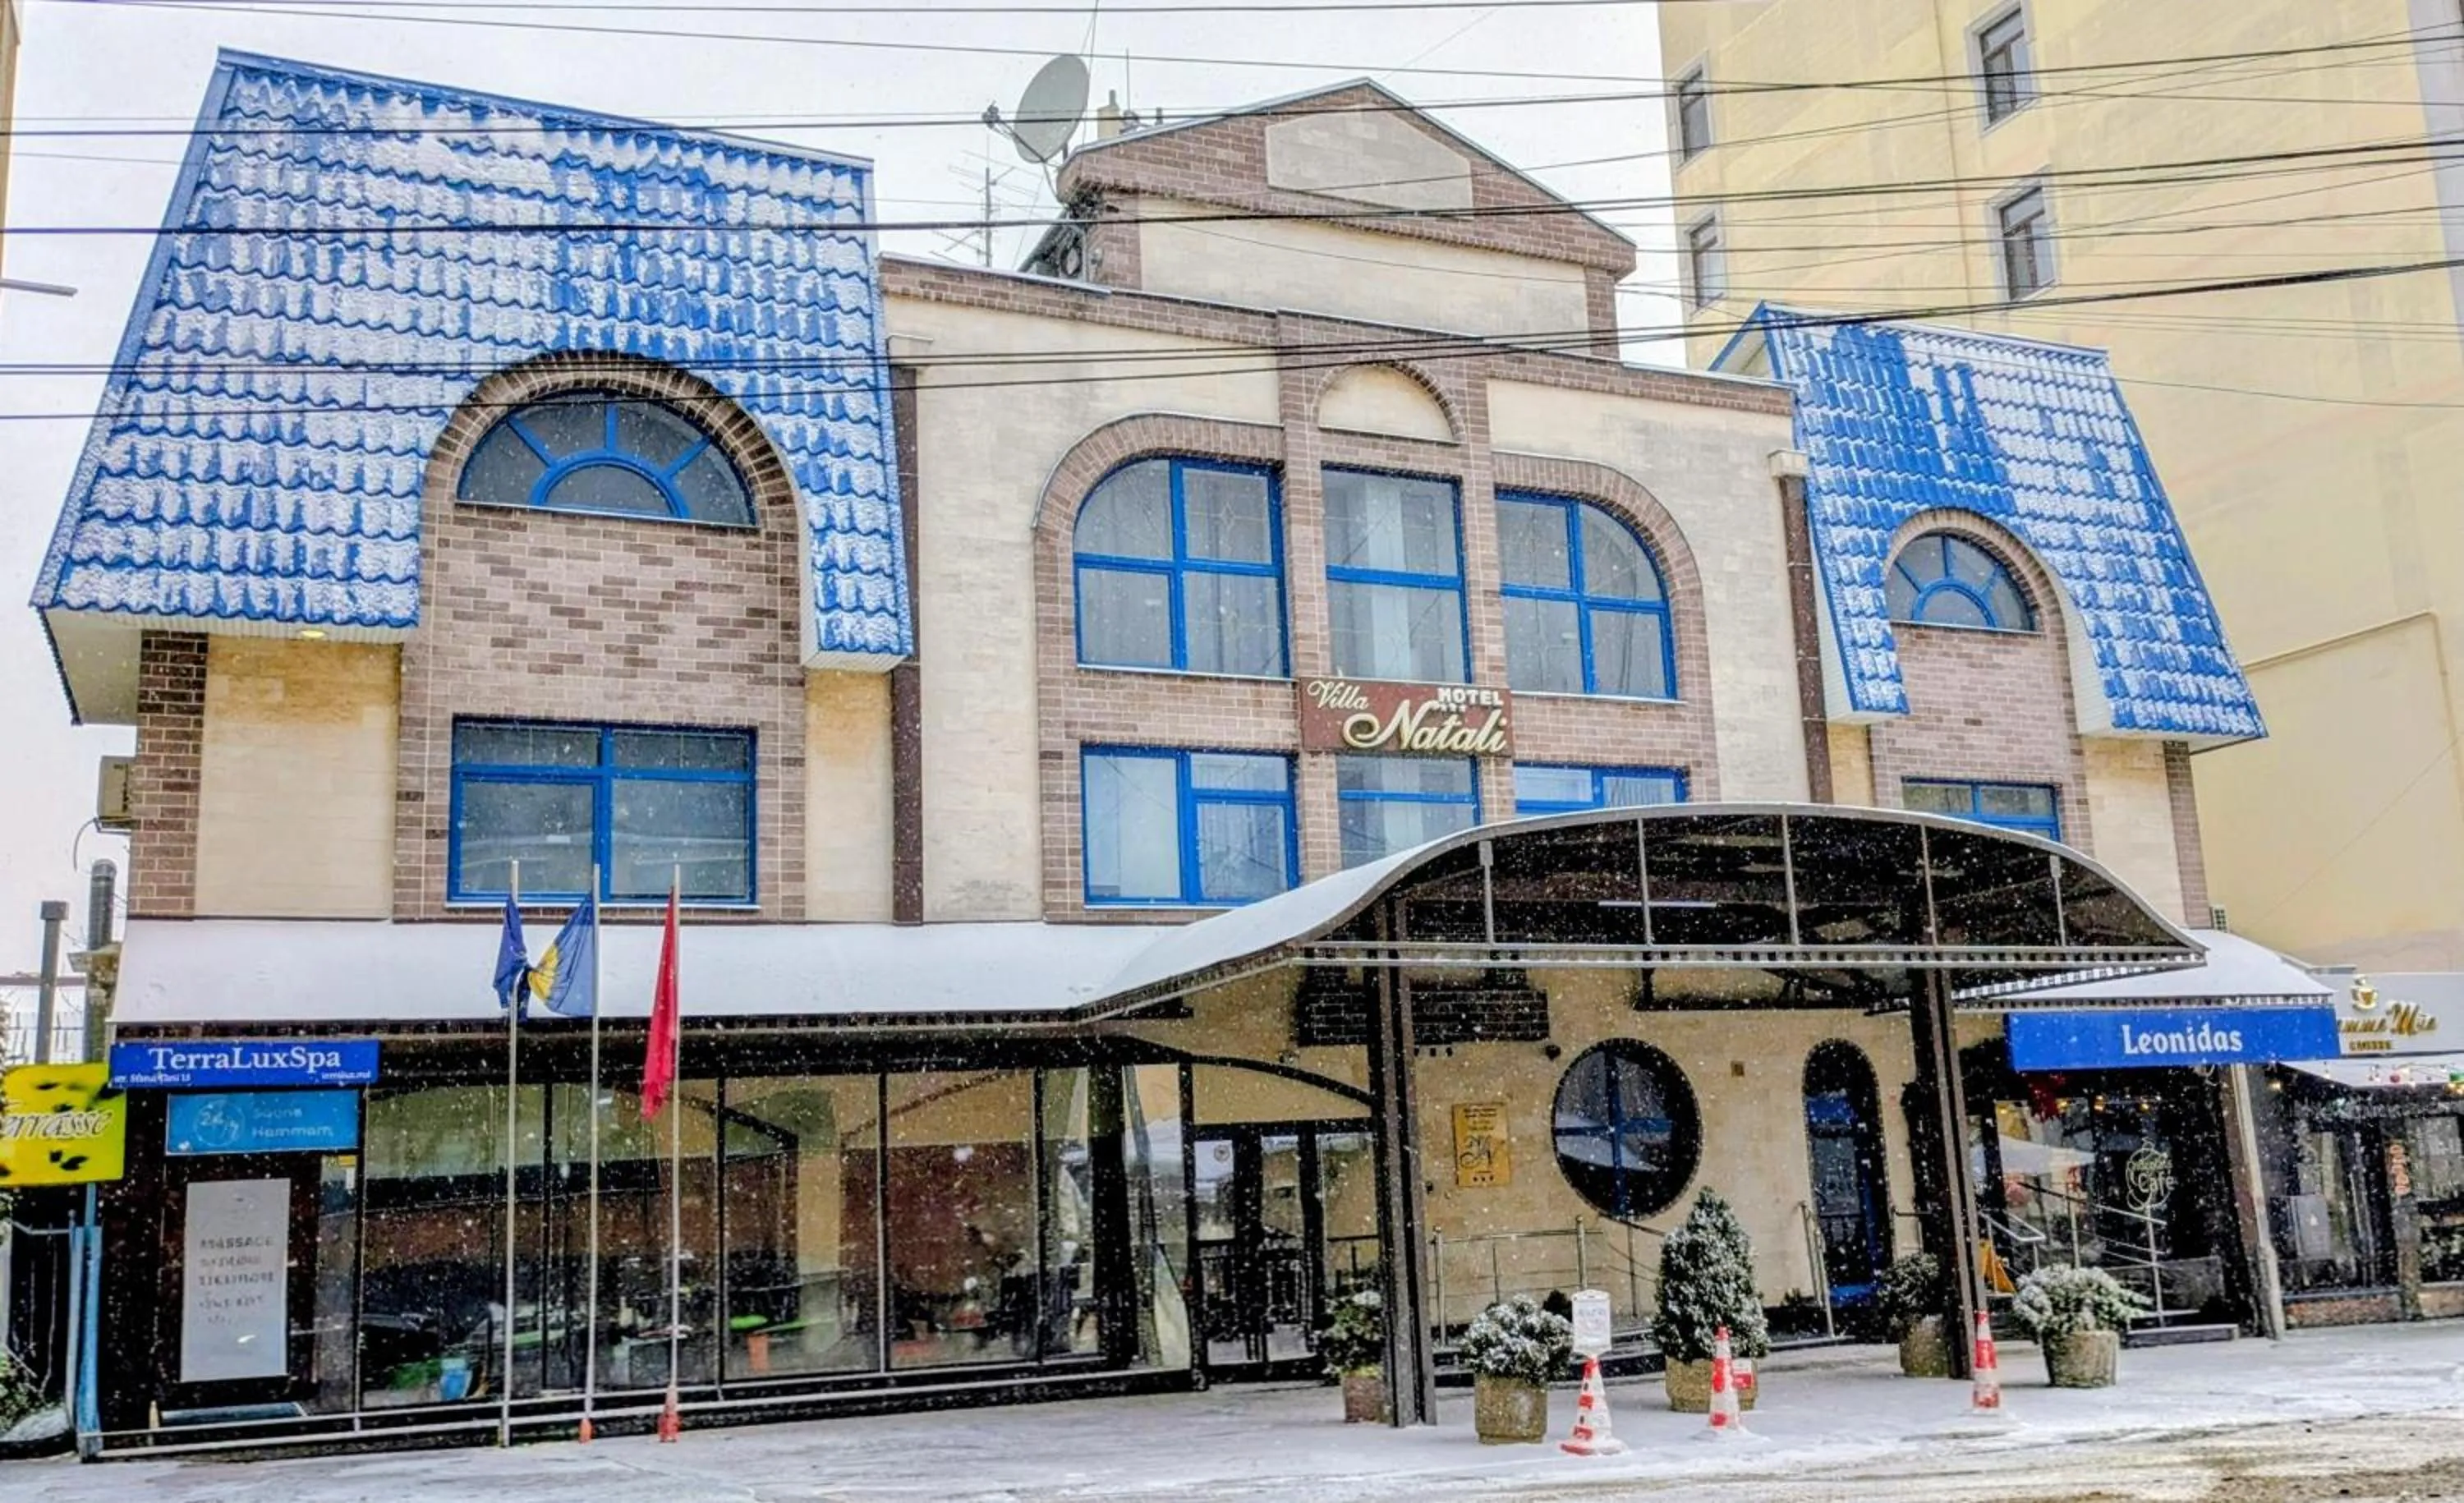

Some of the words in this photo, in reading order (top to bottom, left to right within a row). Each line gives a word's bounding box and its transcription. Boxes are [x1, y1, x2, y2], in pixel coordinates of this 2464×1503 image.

[1307, 680, 1369, 710] Villa
[1437, 687, 1504, 706] HOTEL
[1343, 699, 1507, 752] Natali
[2122, 1021, 2243, 1055] Leonidas
[148, 1046, 341, 1073] TerraLuxSpa
